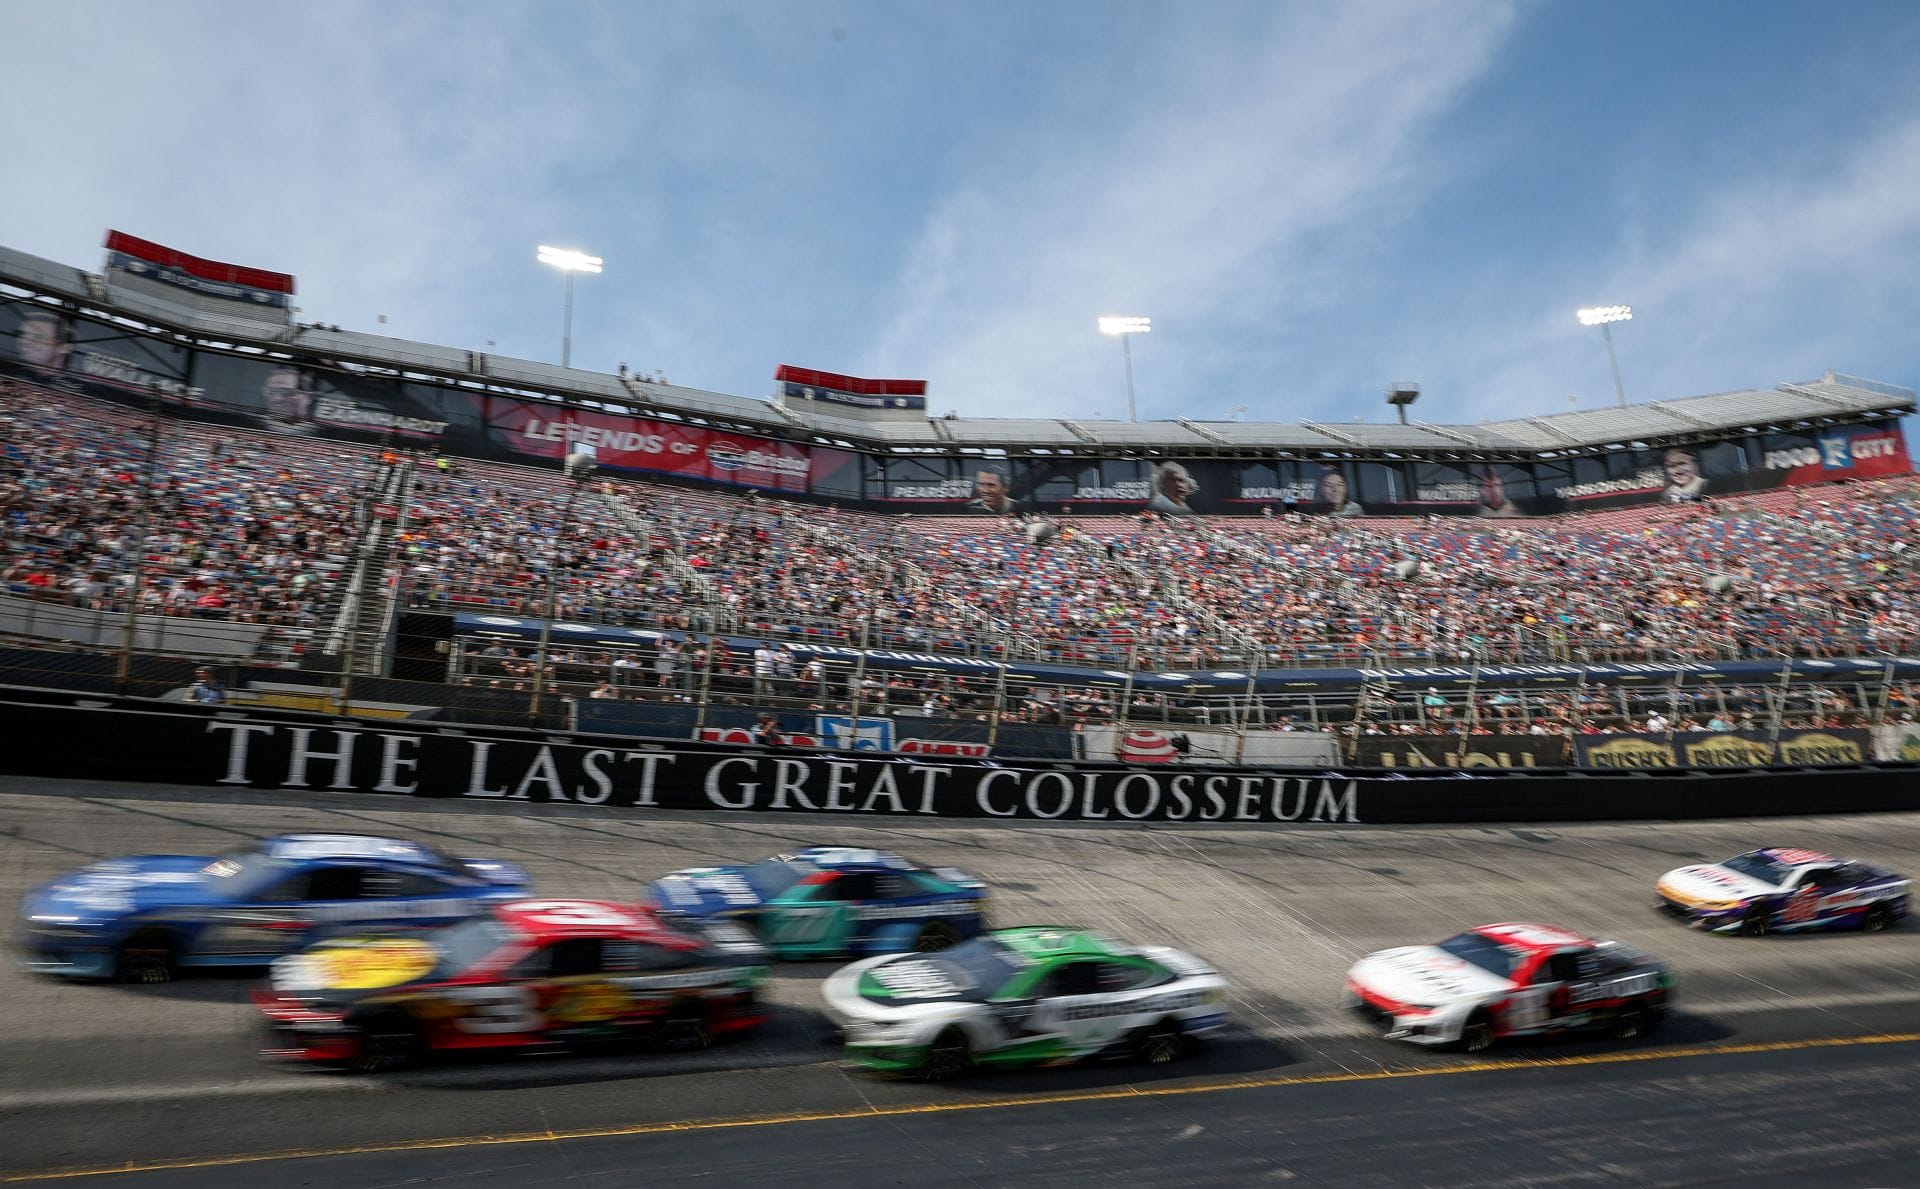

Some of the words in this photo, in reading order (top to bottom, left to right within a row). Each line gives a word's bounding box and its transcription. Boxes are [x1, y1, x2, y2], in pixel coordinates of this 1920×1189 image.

[315, 405, 450, 435] EARNHARDT
[523, 418, 665, 454] LEGENDS
[669, 441, 698, 455] OF
[1764, 446, 1821, 470] FOOD
[1850, 437, 1897, 460] CITY
[893, 486, 973, 498] PEARSON
[1072, 487, 1150, 499] JOHNSON
[206, 719, 423, 795] THE
[463, 740, 676, 806] LAST
[704, 757, 954, 816] GREAT
[975, 768, 1361, 824] COLOSSEUM
[455, 985, 545, 1034] 3
